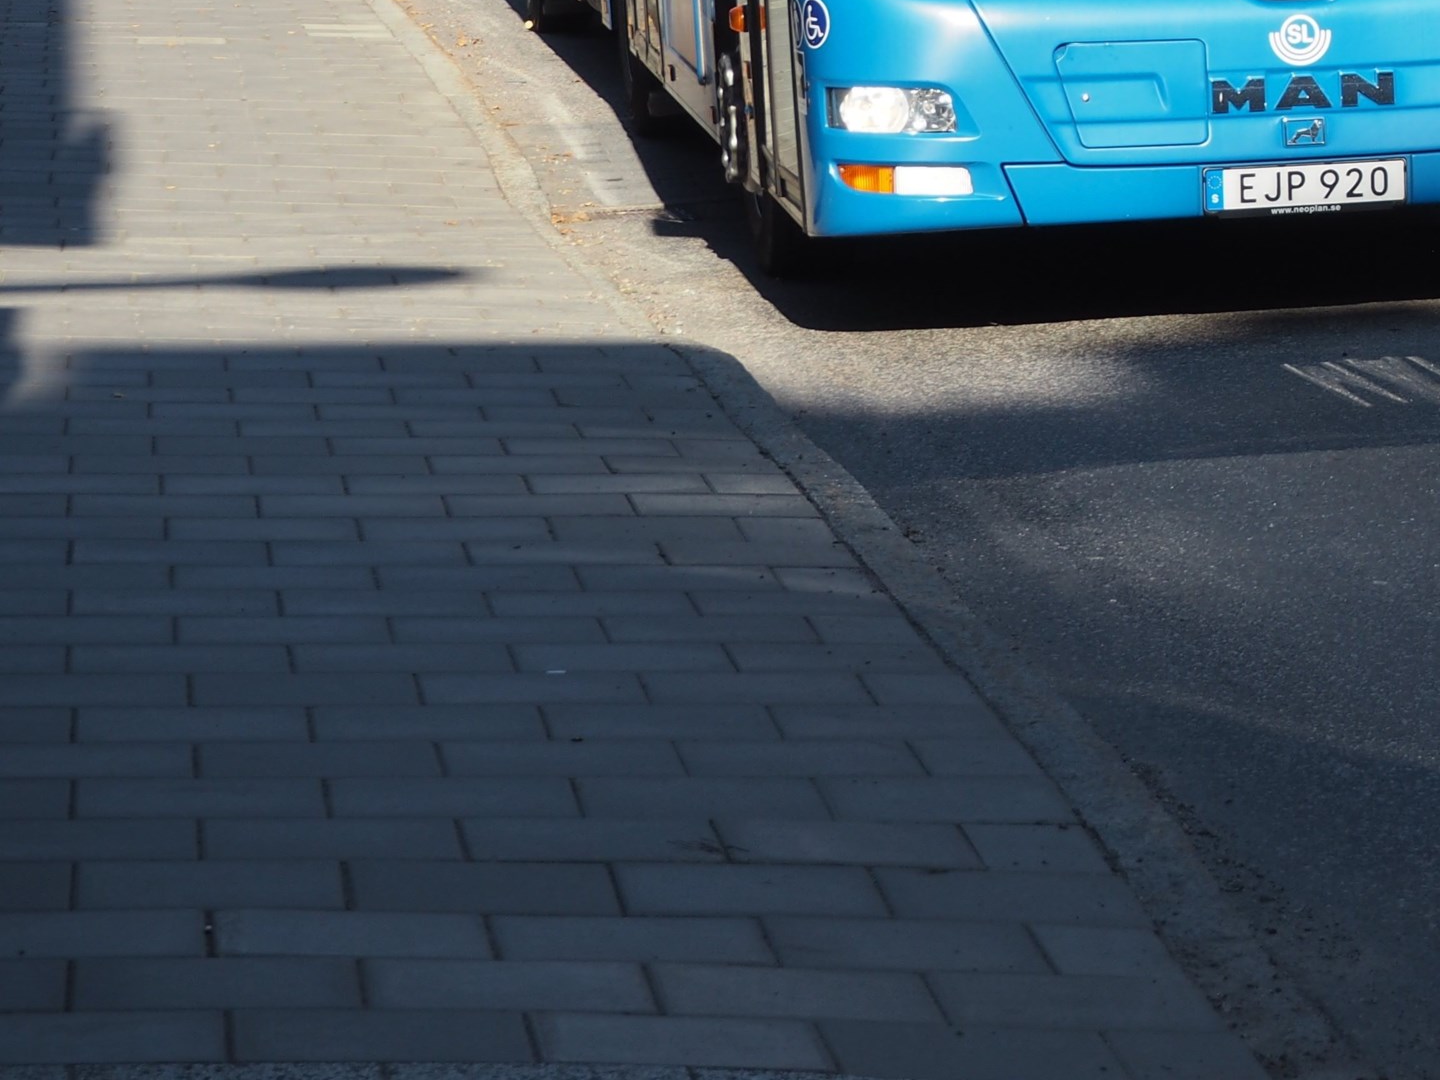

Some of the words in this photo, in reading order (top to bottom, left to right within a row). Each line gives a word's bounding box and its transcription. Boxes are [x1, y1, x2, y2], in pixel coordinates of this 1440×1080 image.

[1287, 24, 1314, 44] SL
[1211, 69, 1396, 115] MAN
[1240, 170, 1305, 204] EJP
[1320, 166, 1388, 199] 920
[1211, 194, 1219, 203] S
[1271, 203, 1341, 215] www.neoplan.se
